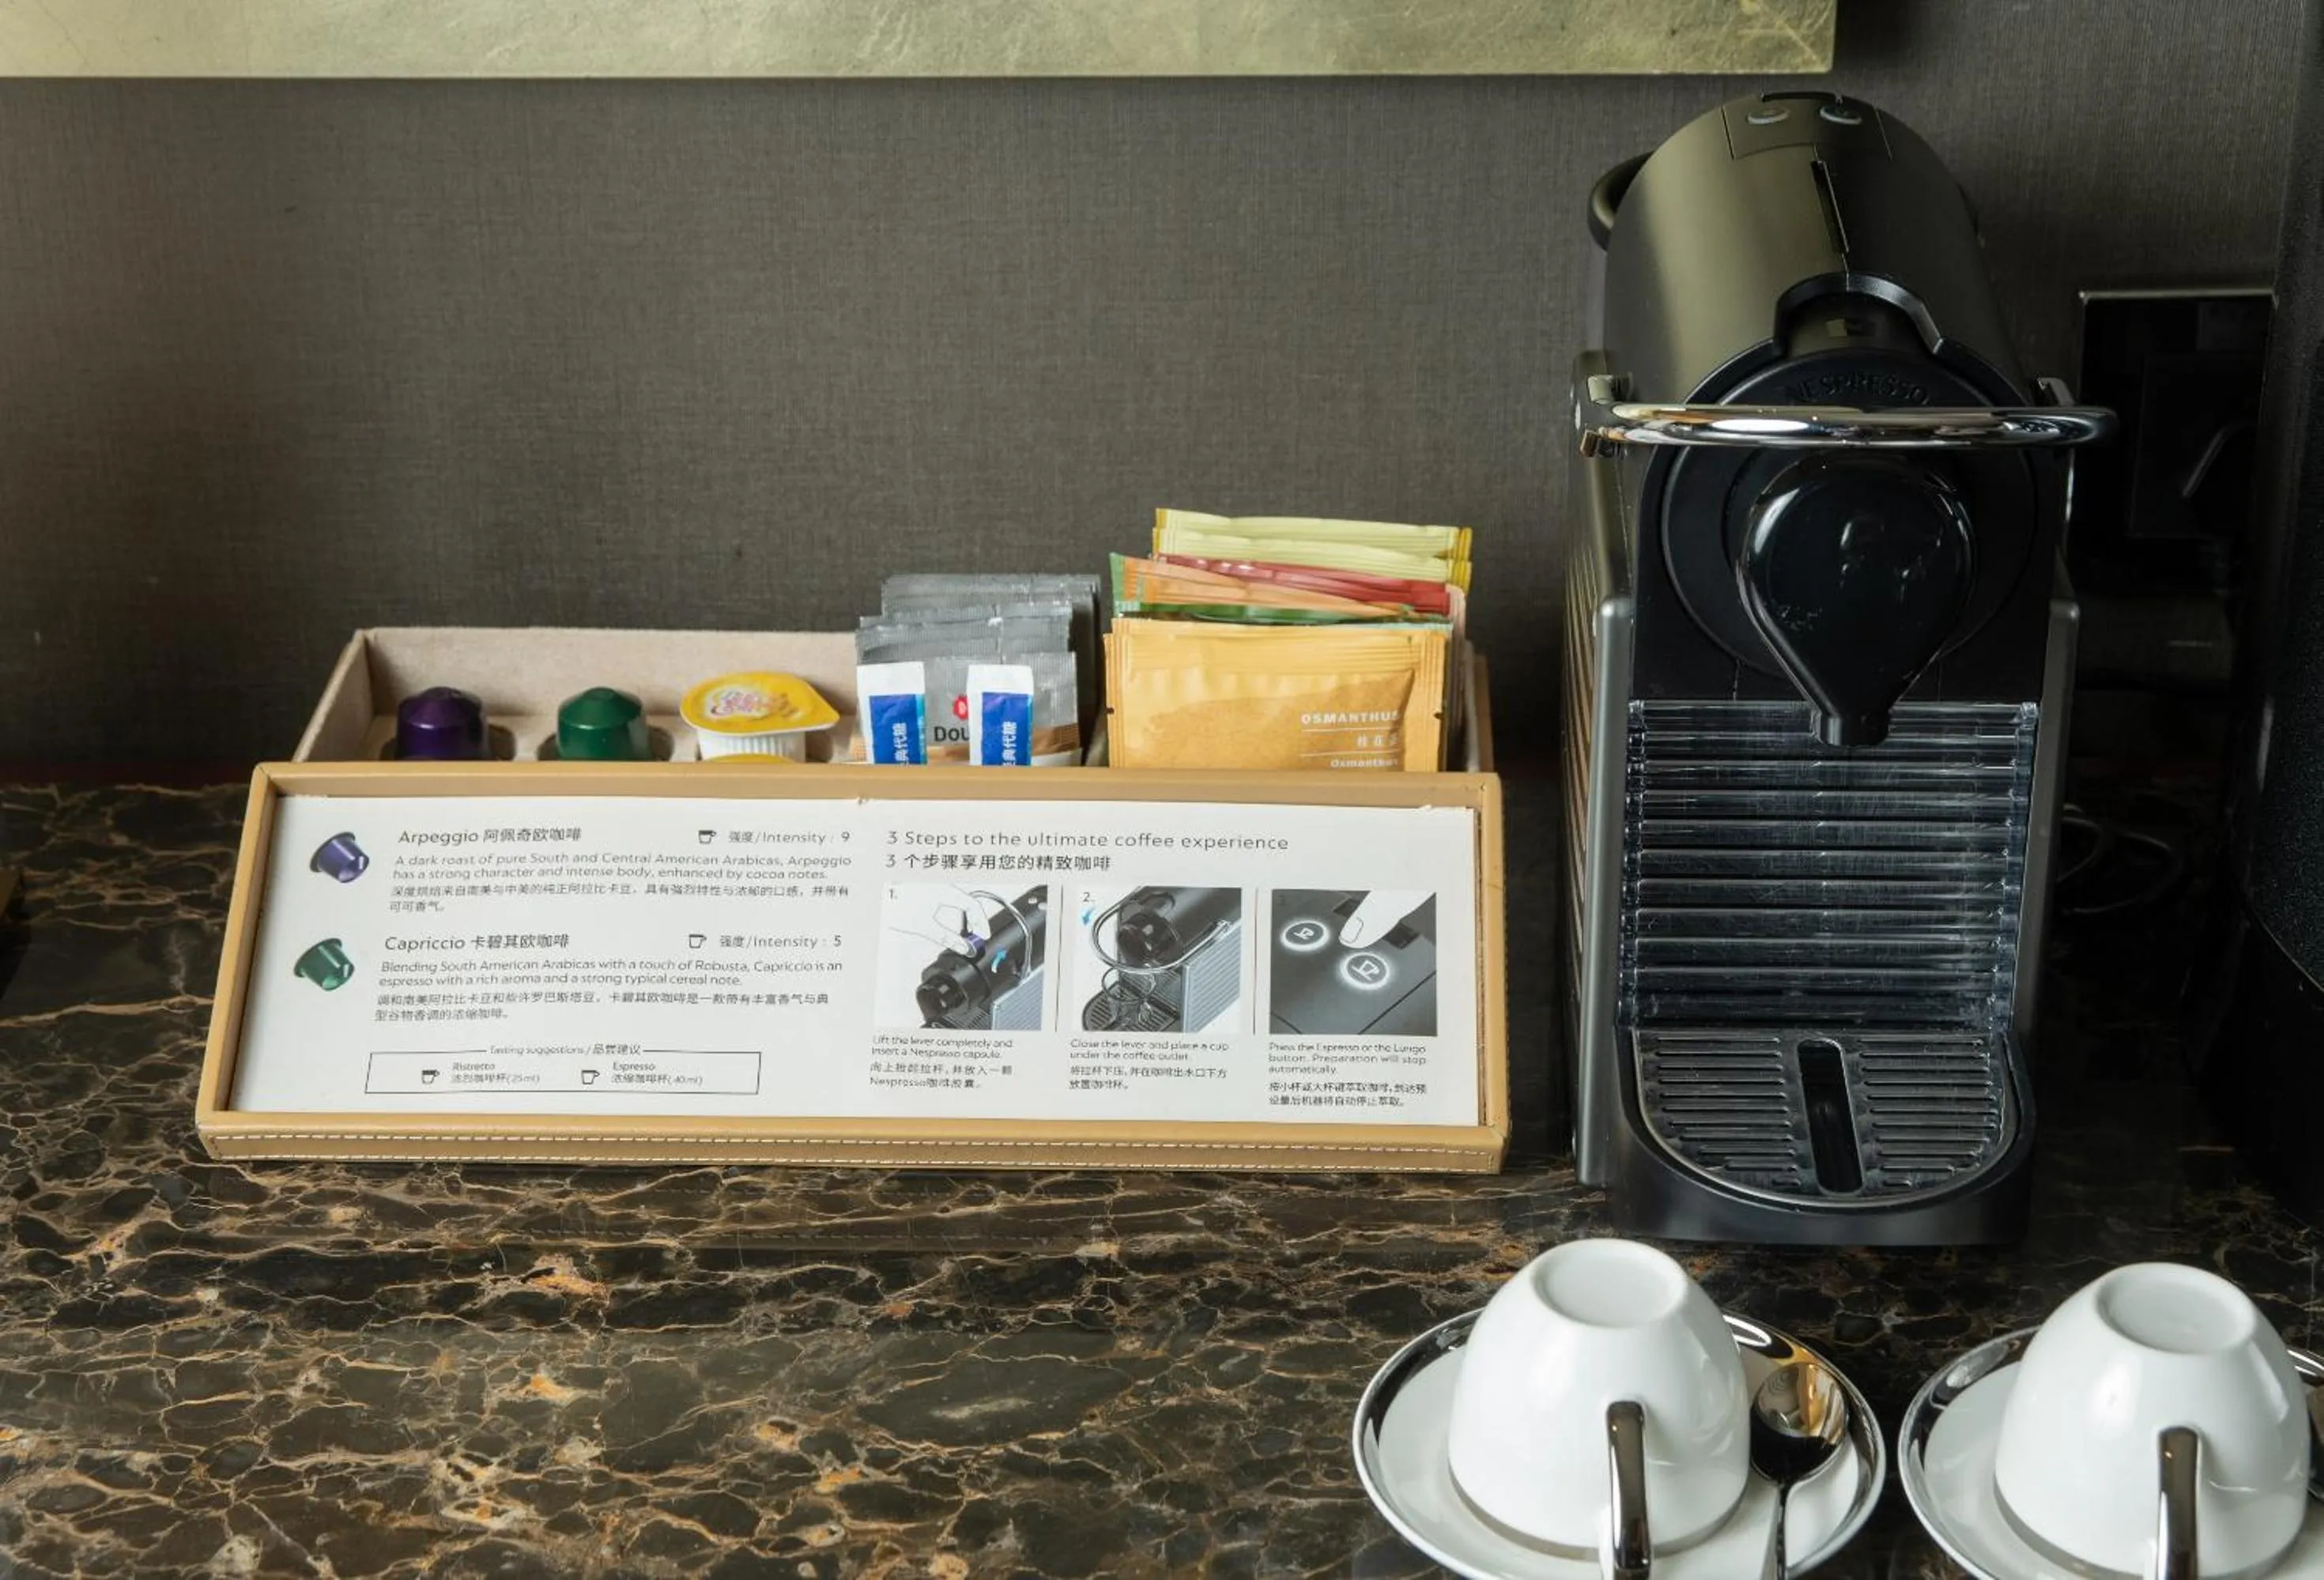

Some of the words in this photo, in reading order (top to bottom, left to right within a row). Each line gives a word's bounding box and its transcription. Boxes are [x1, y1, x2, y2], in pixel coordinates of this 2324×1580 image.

[1300, 711, 1400, 725] OSMANTHUS
[398, 831, 479, 846] Arpeggio
[483, 828, 581, 843] 阿佩奇欧咖啡
[841, 831, 850, 843] 9
[887, 831, 897, 844] 3
[905, 831, 956, 847] Steps
[964, 835, 983, 845] to
[990, 832, 1021, 845] the
[1028, 833, 1108, 847] ultimate
[1115, 833, 1174, 847] coffee
[1181, 835, 1288, 851] experience
[395, 855, 405, 865] A
[408, 854, 438, 865] dark
[441, 854, 474, 865] roast
[478, 854, 494, 865] of
[496, 857, 526, 868] pure
[530, 854, 568, 865] South
[572, 854, 598, 864] and
[602, 854, 652, 864] Central
[655, 854, 719, 865] American
[722, 854, 783, 867] Arabicas,
[787, 854, 852, 868] Arpeggio
[885, 854, 896, 868] 3
[904, 854, 1111, 870] 个步骤享用您的精致咖啡
[393, 869, 415, 880] has
[428, 868, 470, 882] strong
[473, 867, 534, 879] character
[538, 866, 562, 877] and
[566, 866, 613, 877] intense
[616, 866, 655, 881] body,
[658, 867, 723, 878] enhanced
[726, 868, 743, 881] by
[745, 870, 785, 879] cocoa
[787, 868, 828, 879] notes.
[385, 936, 465, 952] Capriccio
[470, 934, 569, 949] 卡碧其欧咖啡
[833, 935, 841, 947] 5
[381, 960, 438, 974] Blending
[440, 959, 477, 971] South
[479, 959, 538, 970] American
[541, 958, 596, 969] Arabicas
[598, 959, 625, 970] with
[639, 959, 676, 970] touch
[677, 959, 692, 970] of
[695, 960, 750, 974] Robusta,
[753, 960, 813, 974] Capriccio
[814, 960, 825, 971] is
[379, 977, 433, 988] espresso
[436, 974, 462, 985] with
[476, 973, 499, 984] rich
[501, 975, 541, 984] aroma
[543, 972, 568, 983] and
[580, 972, 623, 986] strong
[624, 972, 668, 986] typical
[668, 973, 707, 984] cereal
[710, 974, 741, 985] note.
[872, 1035, 889, 1045] Lift
[891, 1035, 909, 1046] the
[910, 1036, 934, 1046] lever
[936, 1036, 992, 1050] completely
[992, 1038, 1013, 1047] and
[1070, 1039, 1100, 1049] Close
[1100, 1039, 1119, 1049] the
[1121, 1040, 1145, 1050] lever
[1149, 1041, 1169, 1050] and
[1170, 1041, 1199, 1053] place
[1209, 1044, 1229, 1054] cup
[1297, 1043, 1315, 1051] the
[1316, 1043, 1360, 1054] Espresso
[1373, 1043, 1391, 1052] the
[1393, 1043, 1427, 1055] Lungo
[490, 1045, 525, 1056] Tasting
[526, 1046, 585, 1056] suggestions
[910, 1048, 961, 1060] Nespresso
[1070, 1050, 1100, 1060] under
[1103, 1051, 1121, 1060] the
[1122, 1051, 1155, 1060] coffee
[613, 1062, 656, 1072] Espresso
[1311, 1054, 1379, 1065] Preparation
[1379, 1054, 1400, 1063] will
[1402, 1054, 1427, 1066] stop
